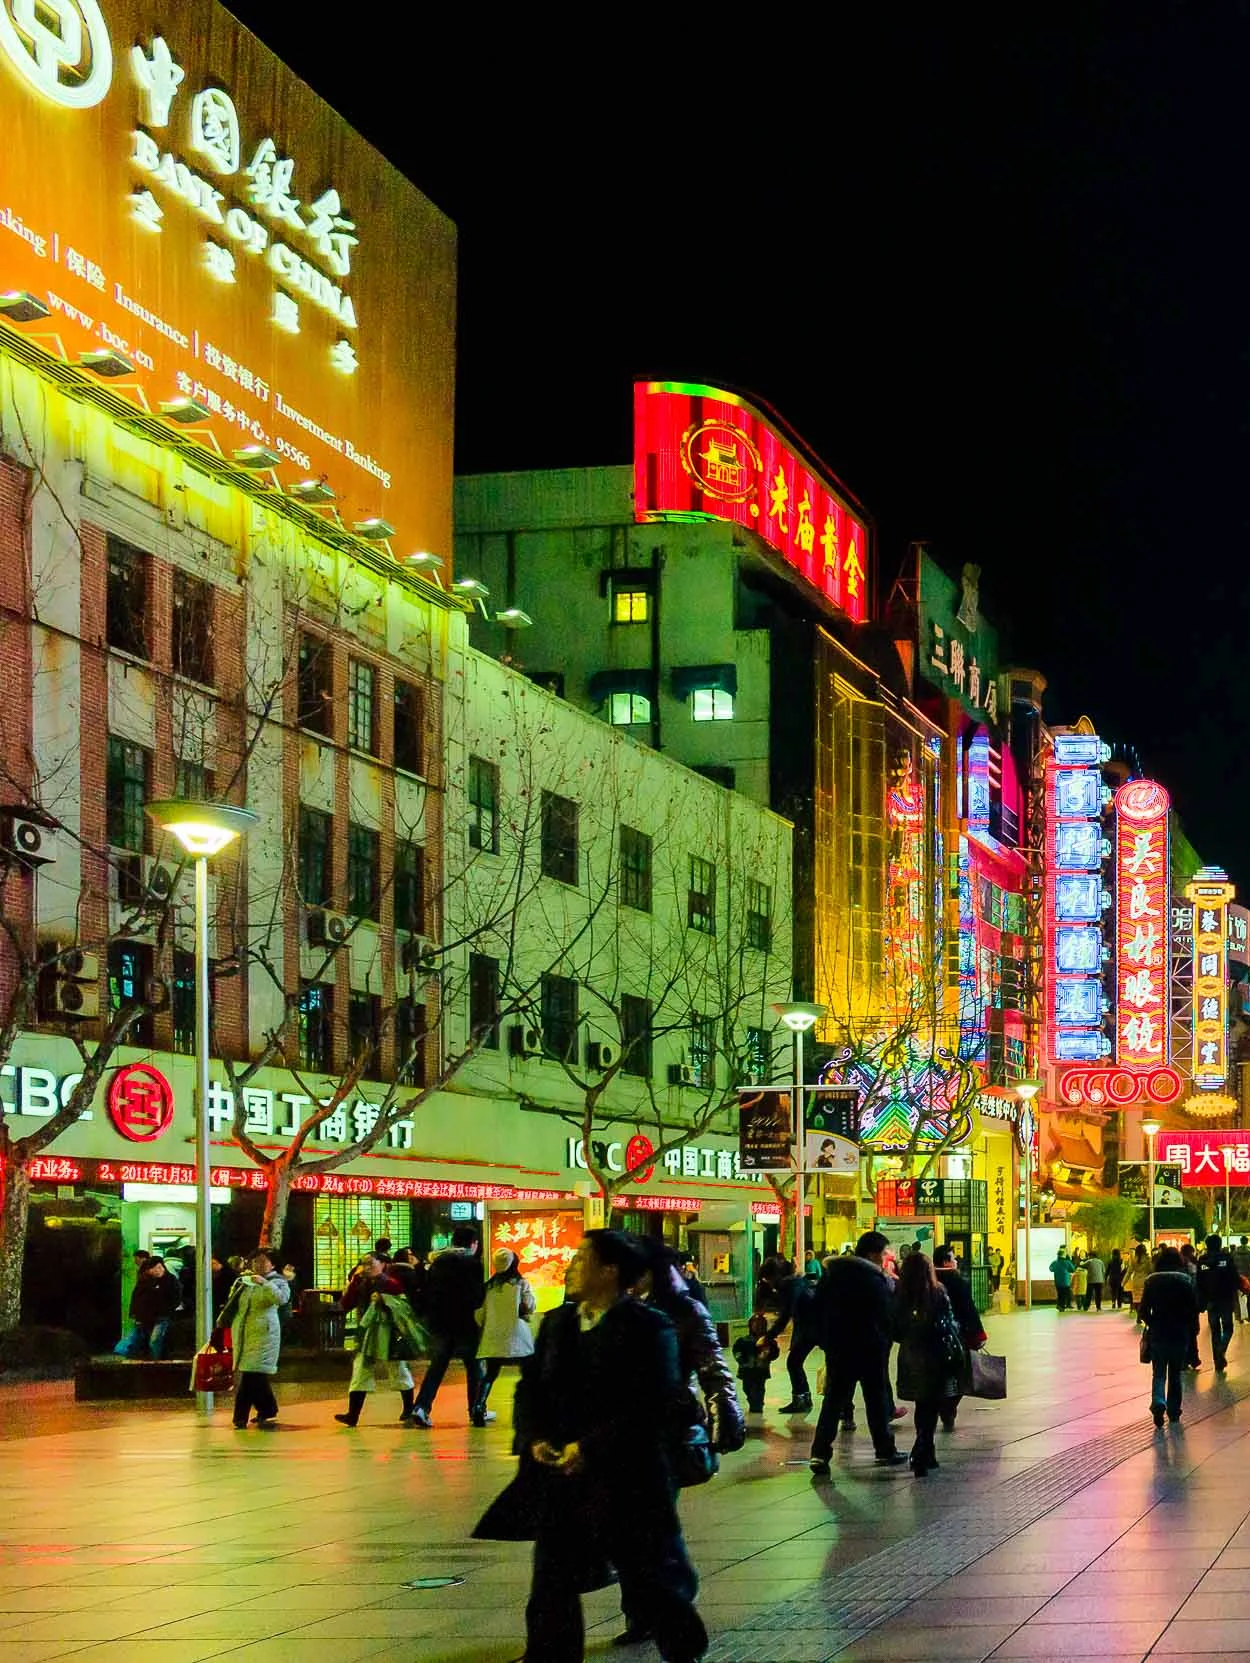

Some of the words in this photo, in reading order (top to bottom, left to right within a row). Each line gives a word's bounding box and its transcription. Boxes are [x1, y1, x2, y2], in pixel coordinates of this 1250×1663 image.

[129, 130, 225, 225] BANK
[226, 207, 268, 254] OF
[267, 242, 358, 328] CHINA
[48, 291, 155, 371] www.boc.cn
[115, 282, 189, 348] Insurance
[275, 393, 345, 453] Investment
[345, 439, 391, 489] Banking
[276, 437, 312, 471] 95566
[207, 1081, 415, 1148] 中国工商银行
[1166, 1143, 1250, 1174] 周大福
